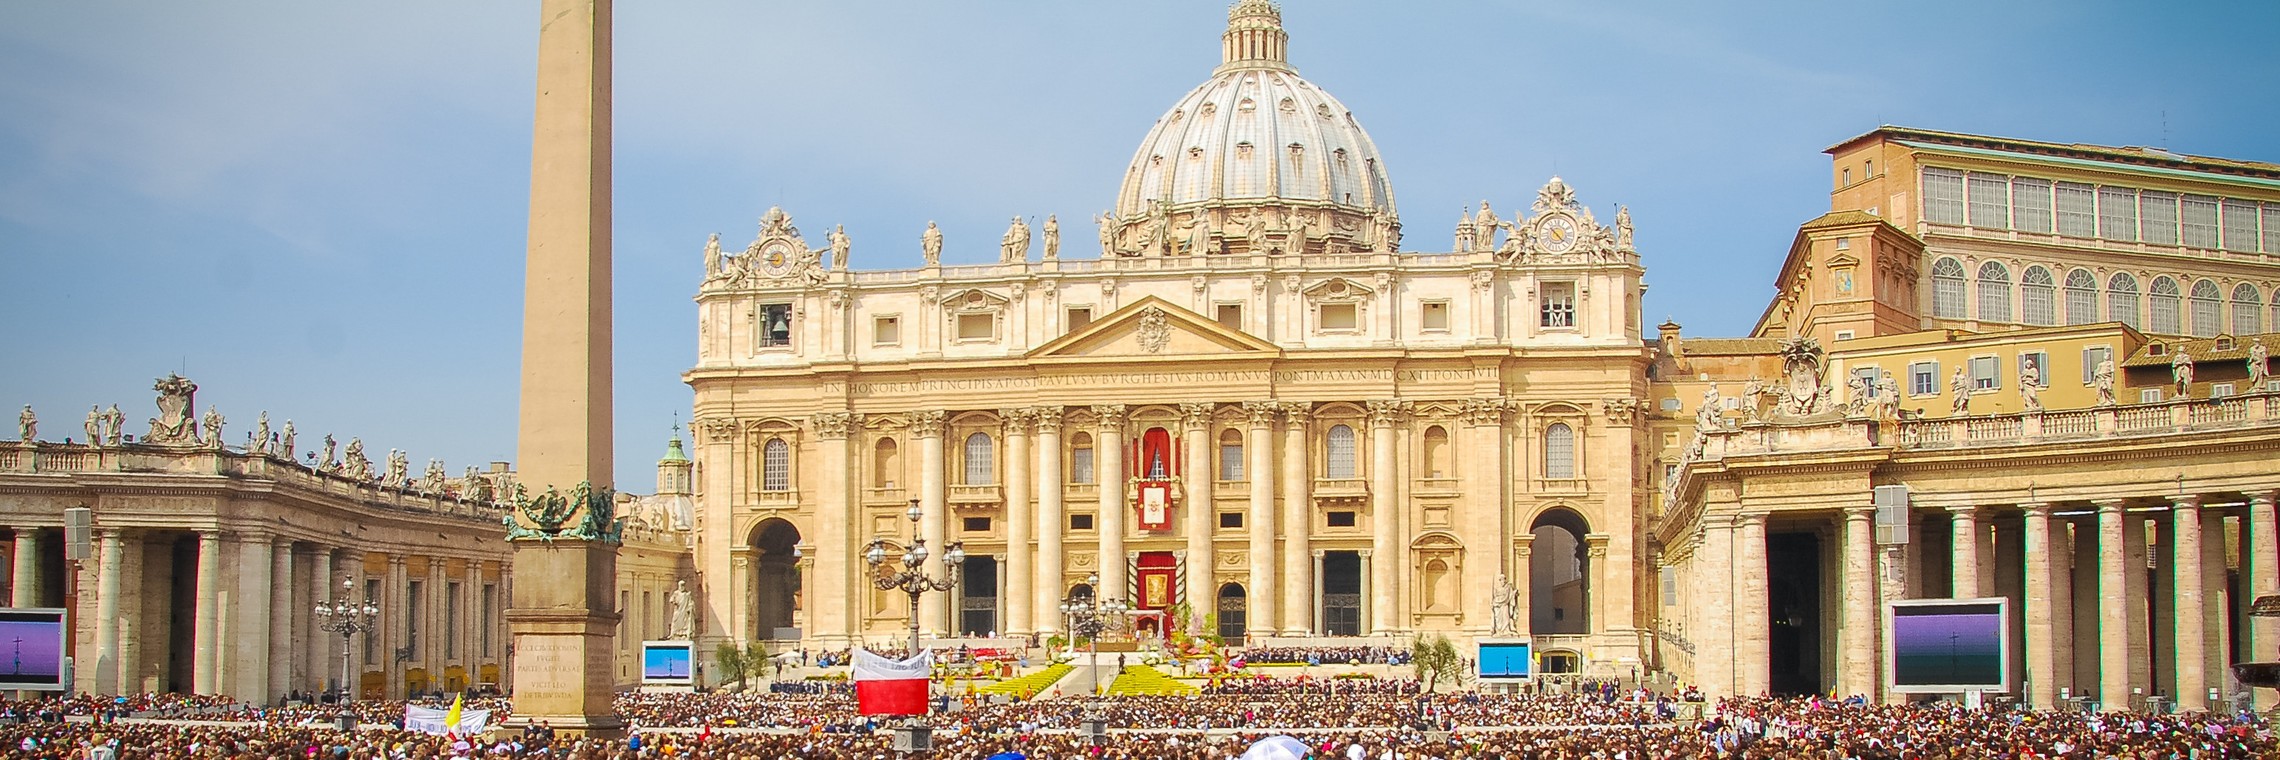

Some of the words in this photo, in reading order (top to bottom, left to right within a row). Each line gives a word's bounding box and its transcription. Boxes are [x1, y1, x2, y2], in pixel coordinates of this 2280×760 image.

[825, 382, 841, 393] IN
[850, 382, 919, 394] HONOREM
[921, 379, 992, 391] PRINCIPIS
[993, 377, 1038, 388] APOST
[1039, 374, 1087, 386] PAVLVS
[1102, 372, 1191, 385] BVRGHESIVS
[1196, 370, 1270, 383] ROMANVS
[1275, 370, 1311, 382] PONT
[1313, 370, 1346, 382] MAX
[1434, 369, 1475, 380] PONT
[1477, 367, 1498, 379] VII
